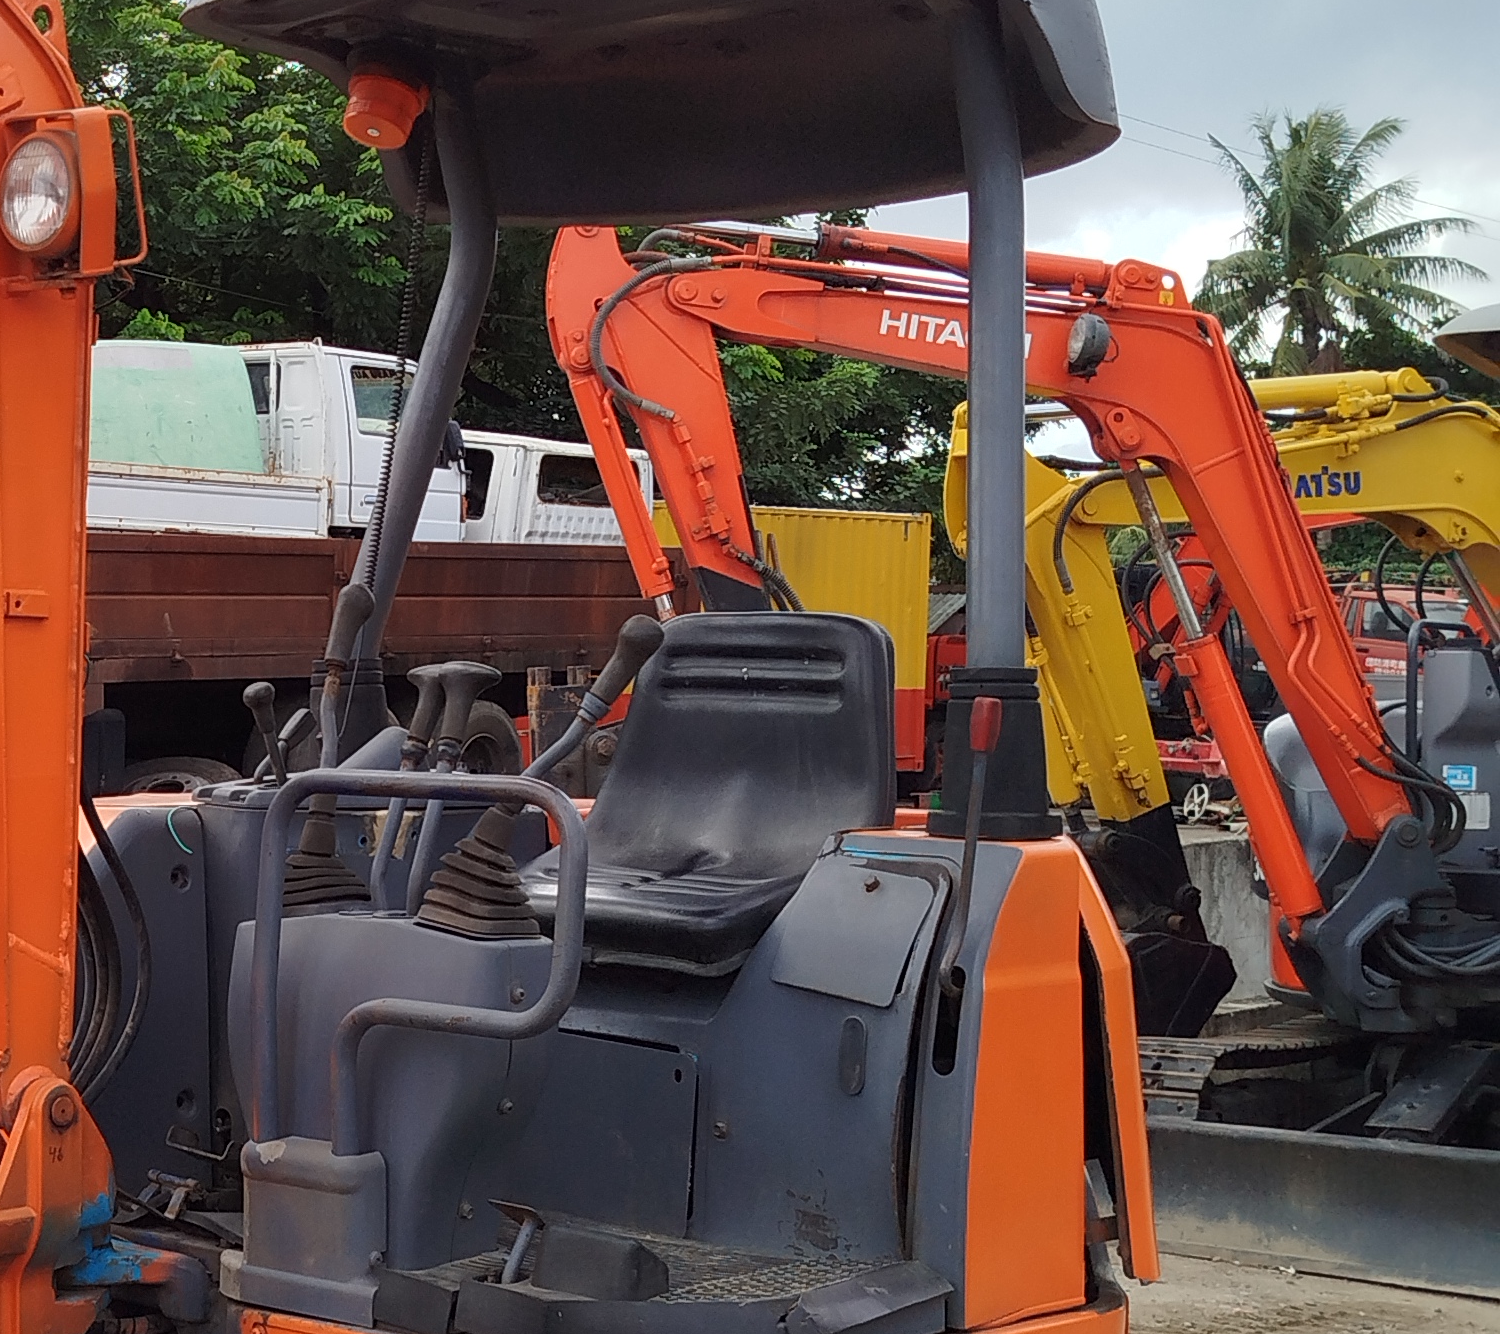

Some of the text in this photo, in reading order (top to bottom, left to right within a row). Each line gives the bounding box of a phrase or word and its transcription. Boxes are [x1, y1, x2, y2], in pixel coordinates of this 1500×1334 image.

[879, 308, 1033, 360] HITAI
[1294, 465, 1362, 499] ATSU
[48, 1146, 64, 1164] 46
